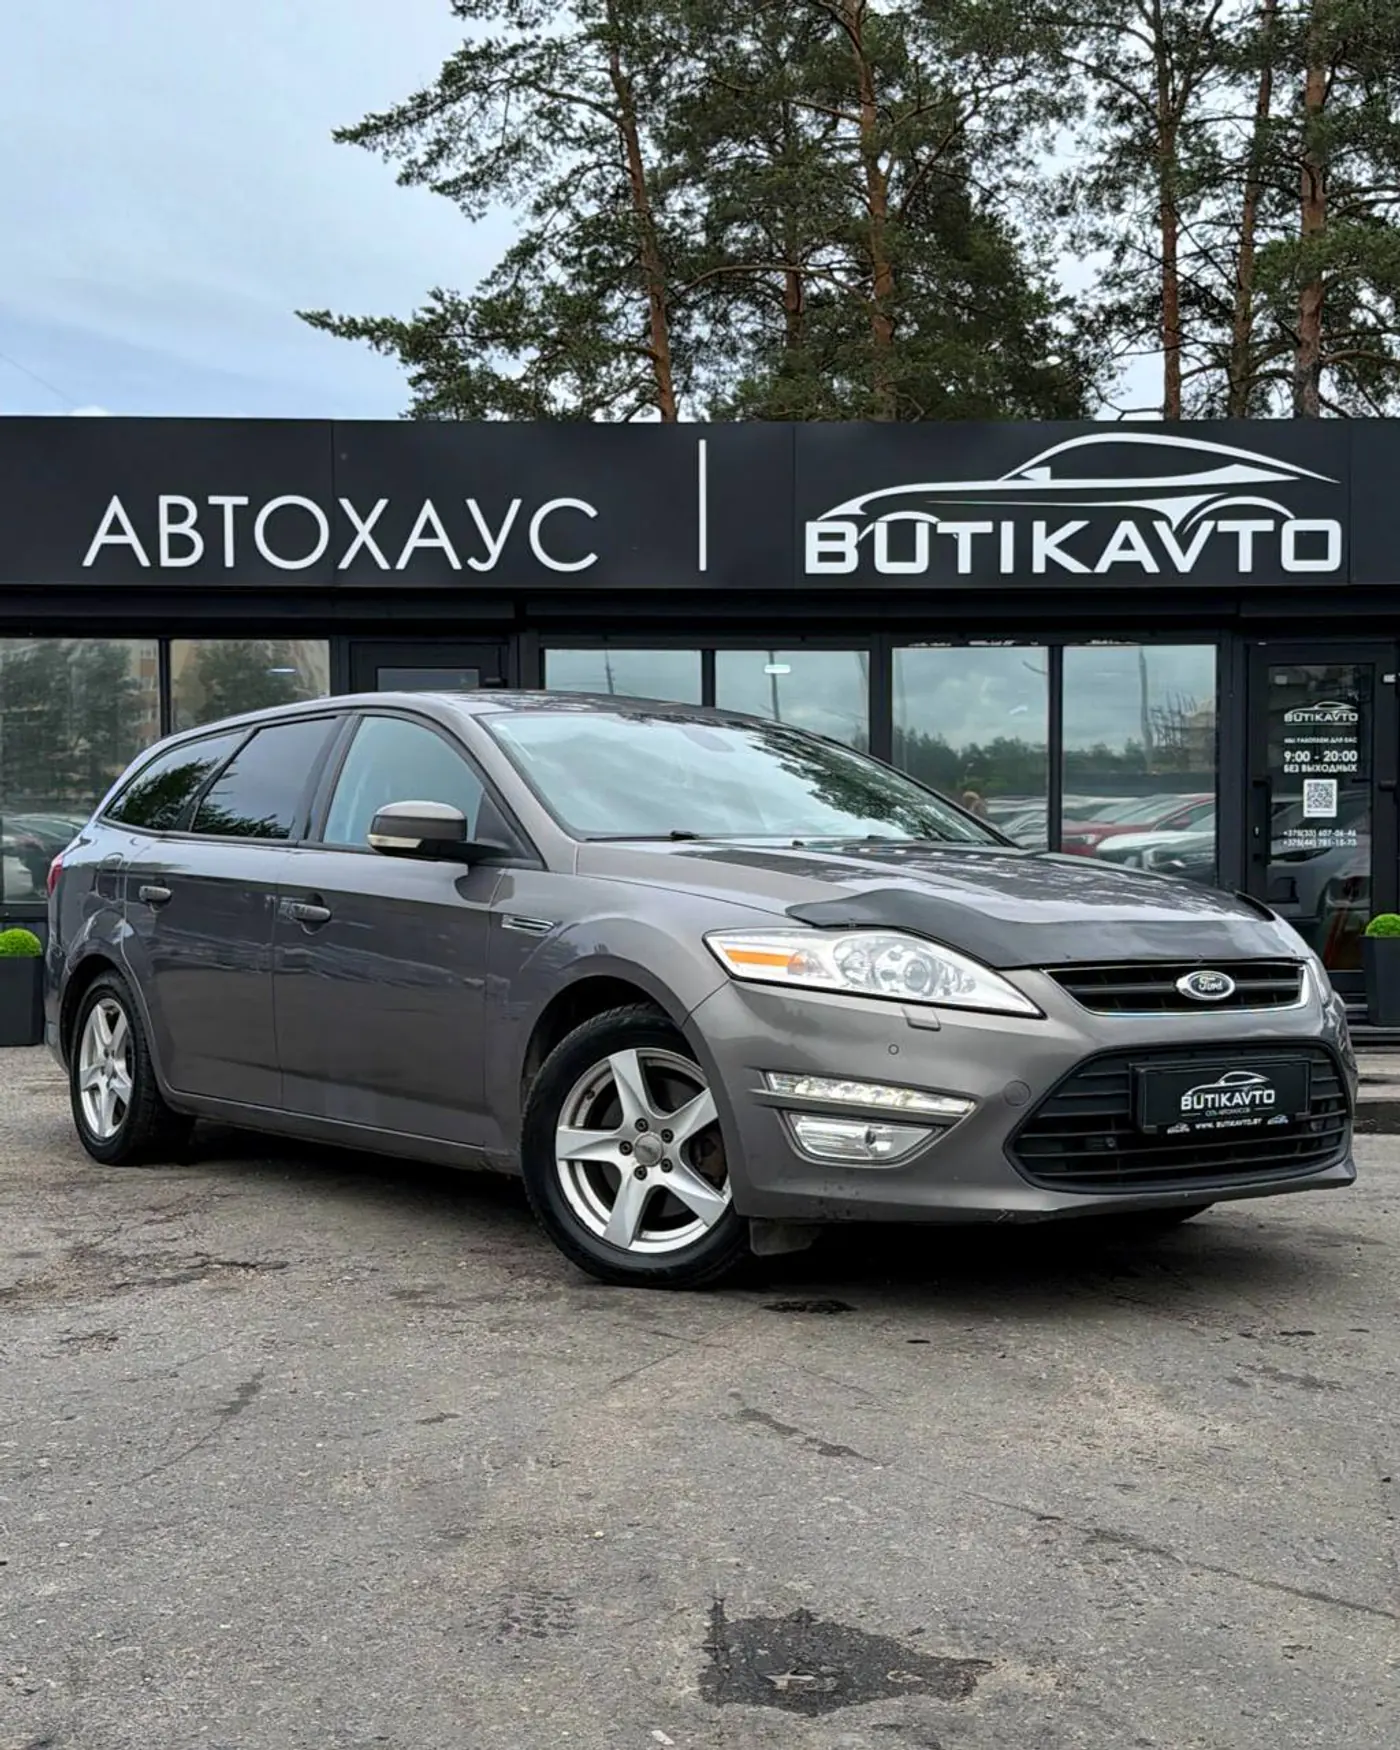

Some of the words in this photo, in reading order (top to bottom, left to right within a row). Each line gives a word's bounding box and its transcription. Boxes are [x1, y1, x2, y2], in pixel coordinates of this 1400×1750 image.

[82, 494, 598, 573] АВТОХАУС
[804, 518, 1342, 575] BUTIKAVTO
[1283, 712, 1359, 723] BUTIKAVTO
[1283, 750, 1311, 763] 9:00
[1323, 750, 1358, 762] 20:00
[1283, 764, 1299, 773] БЕЗ
[1301, 764, 1358, 773] ВЫХОДНЫХ
[1198, 976, 1223, 991] Ford
[1180, 1089, 1276, 1111] BUTIKAVTO
